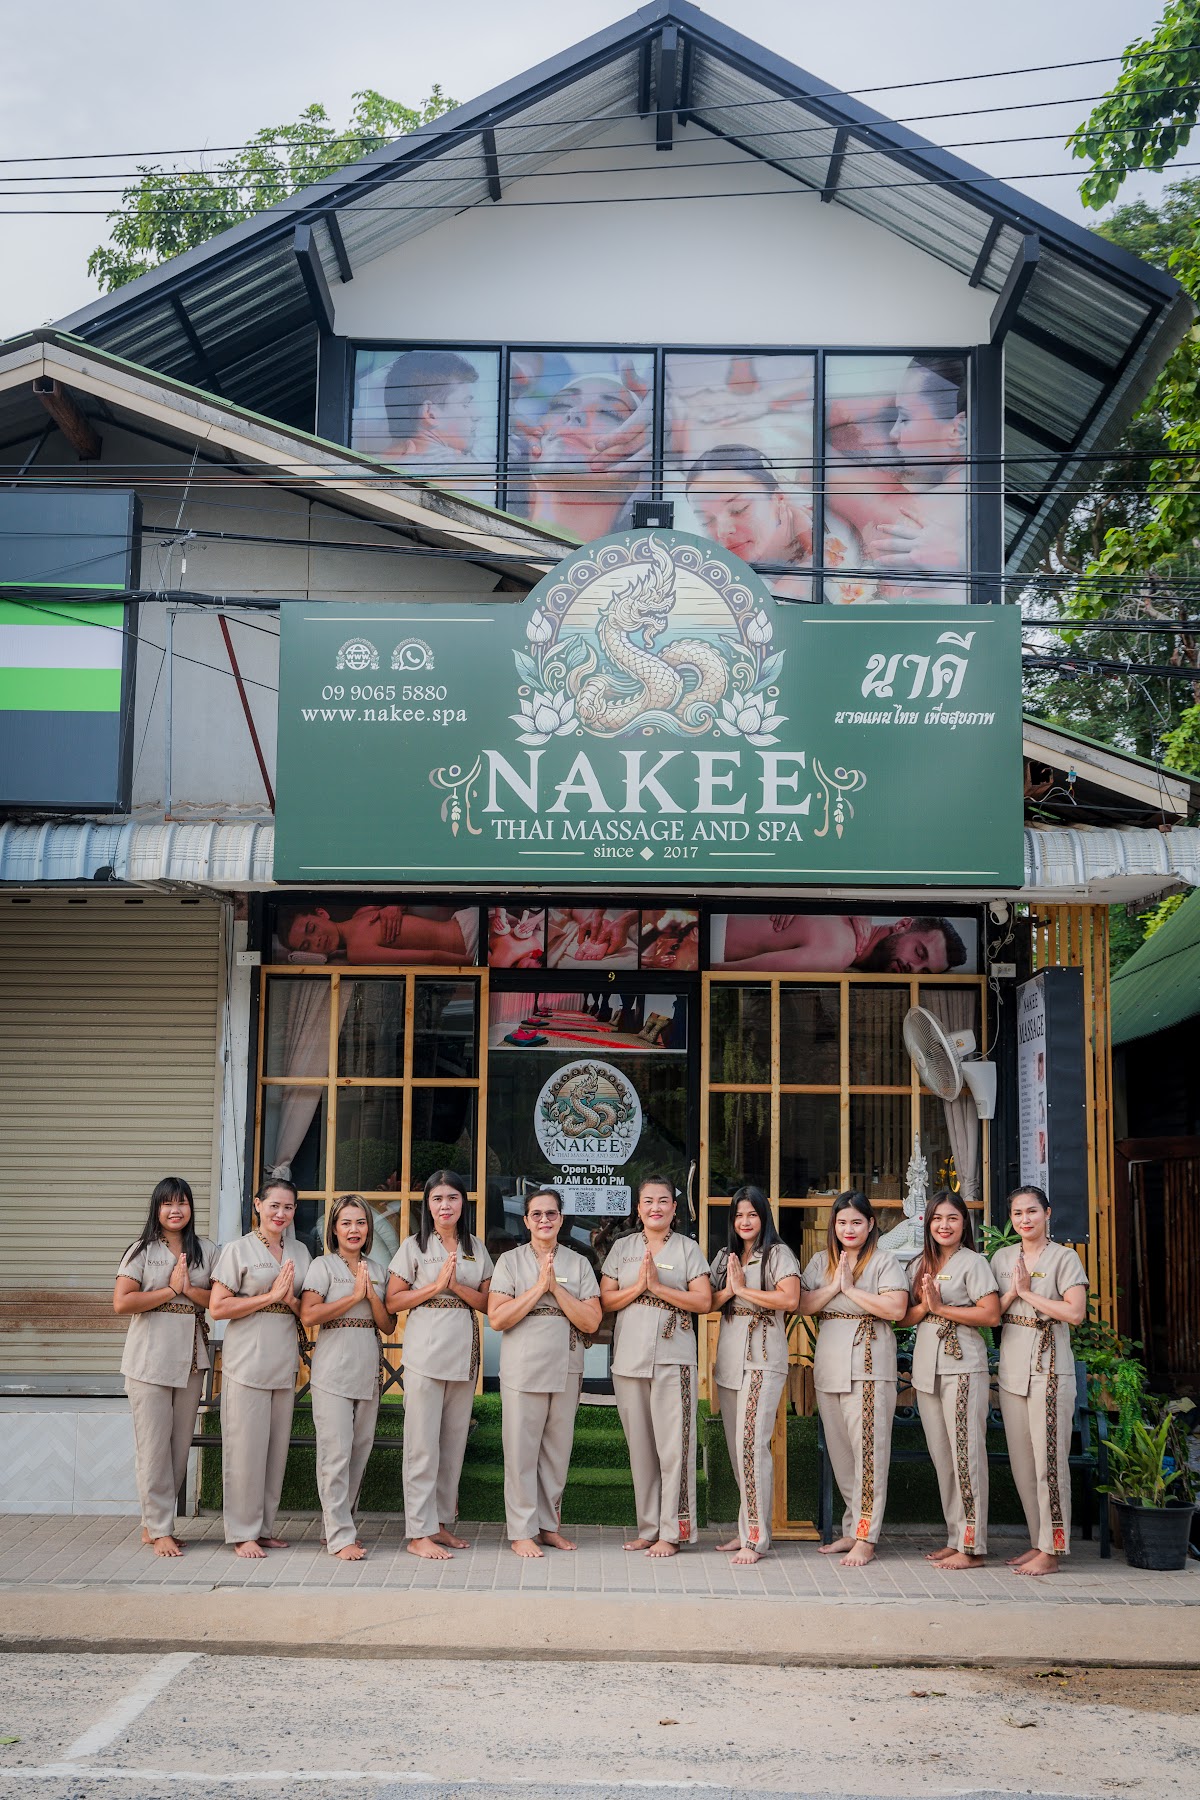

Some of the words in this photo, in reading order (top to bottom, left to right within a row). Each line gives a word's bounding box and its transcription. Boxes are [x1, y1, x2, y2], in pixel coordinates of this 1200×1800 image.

[861, 631, 976, 699] นาคี
[322, 685, 345, 701] 09
[350, 685, 396, 701] 9065
[402, 685, 447, 701] 5880
[301, 705, 468, 726] www.nakee.spa
[834, 703, 919, 725] นวดแผนไทย
[923, 702, 996, 730] เพื่อสุขภาพ
[481, 750, 811, 815] NAKEE
[491, 819, 555, 841] THAI
[561, 820, 684, 841] MASSAGE
[691, 820, 750, 842] AND
[757, 821, 803, 843] SPA
[593, 844, 634, 858] since
[663, 846, 699, 859] 2017
[608, 971, 616, 982] 9
[1023, 992, 1039, 1013] NAKEE
[1018, 1014, 1044, 1045] MASSAGE
[555, 1138, 620, 1153] NAKEE
[561, 1164, 588, 1175] Open
[590, 1165, 614, 1175] Daily
[552, 1176, 563, 1184] 10
[564, 1176, 580, 1184] AM
[583, 1176, 593, 1185] to
[596, 1177, 607, 1185] 10
[609, 1177, 625, 1185] PM
